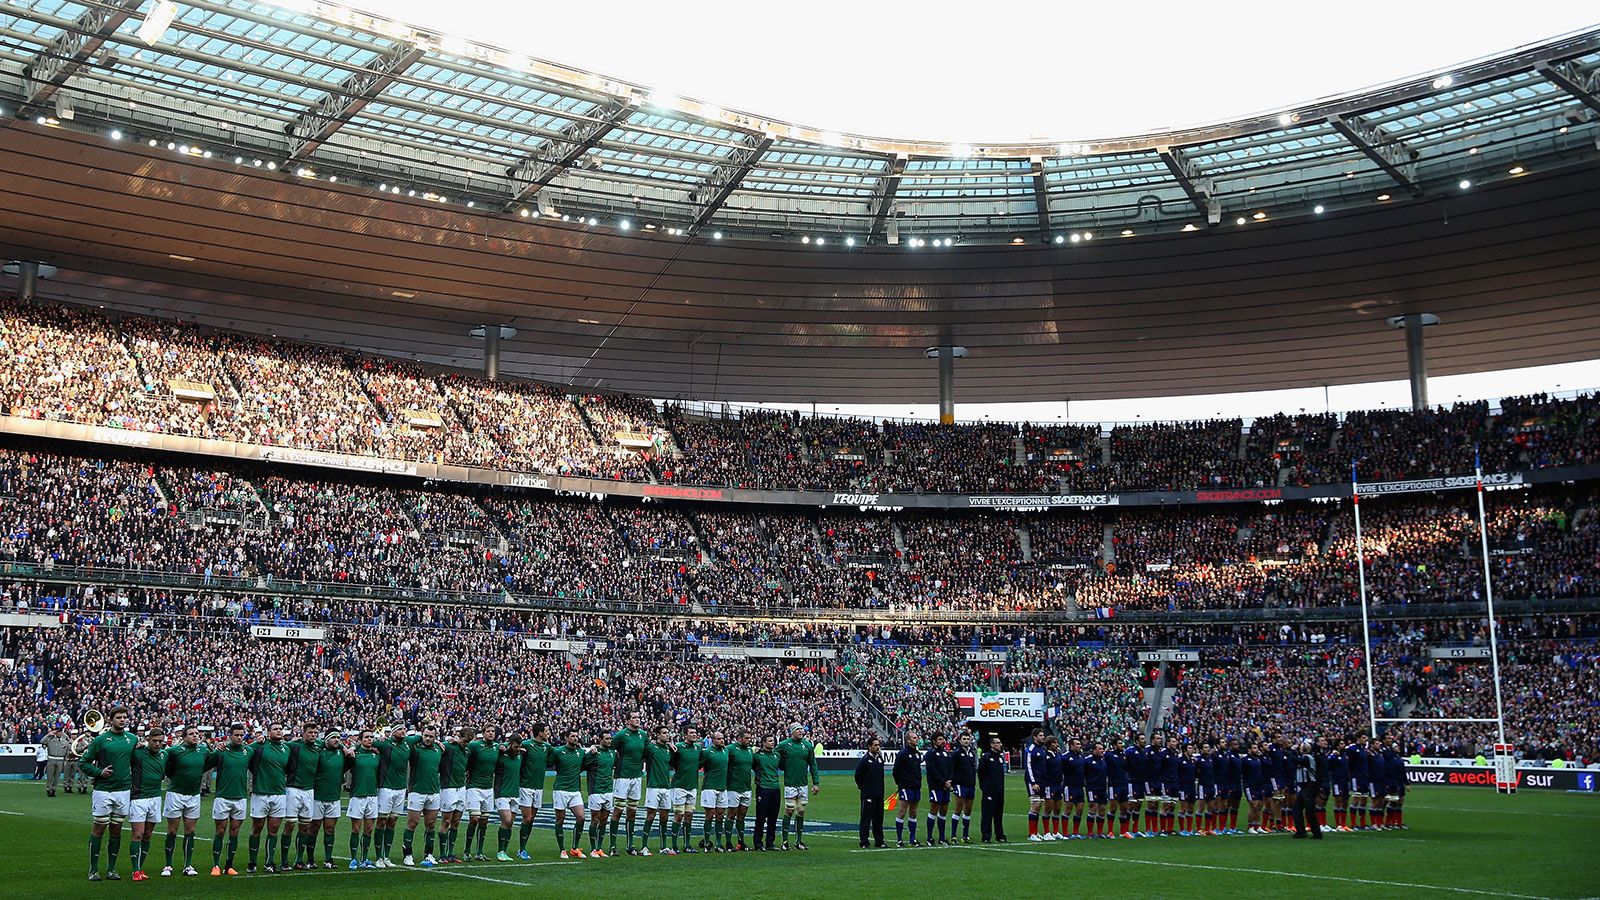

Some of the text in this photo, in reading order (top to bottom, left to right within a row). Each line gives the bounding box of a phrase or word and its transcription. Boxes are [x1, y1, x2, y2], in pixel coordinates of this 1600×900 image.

[1378, 480, 1445, 492] L'EXCEPTIONNEL
[980, 709, 1042, 718] GENERALE
[1406, 771, 1446, 783] uvez
[1526, 774, 1553, 787] sur
